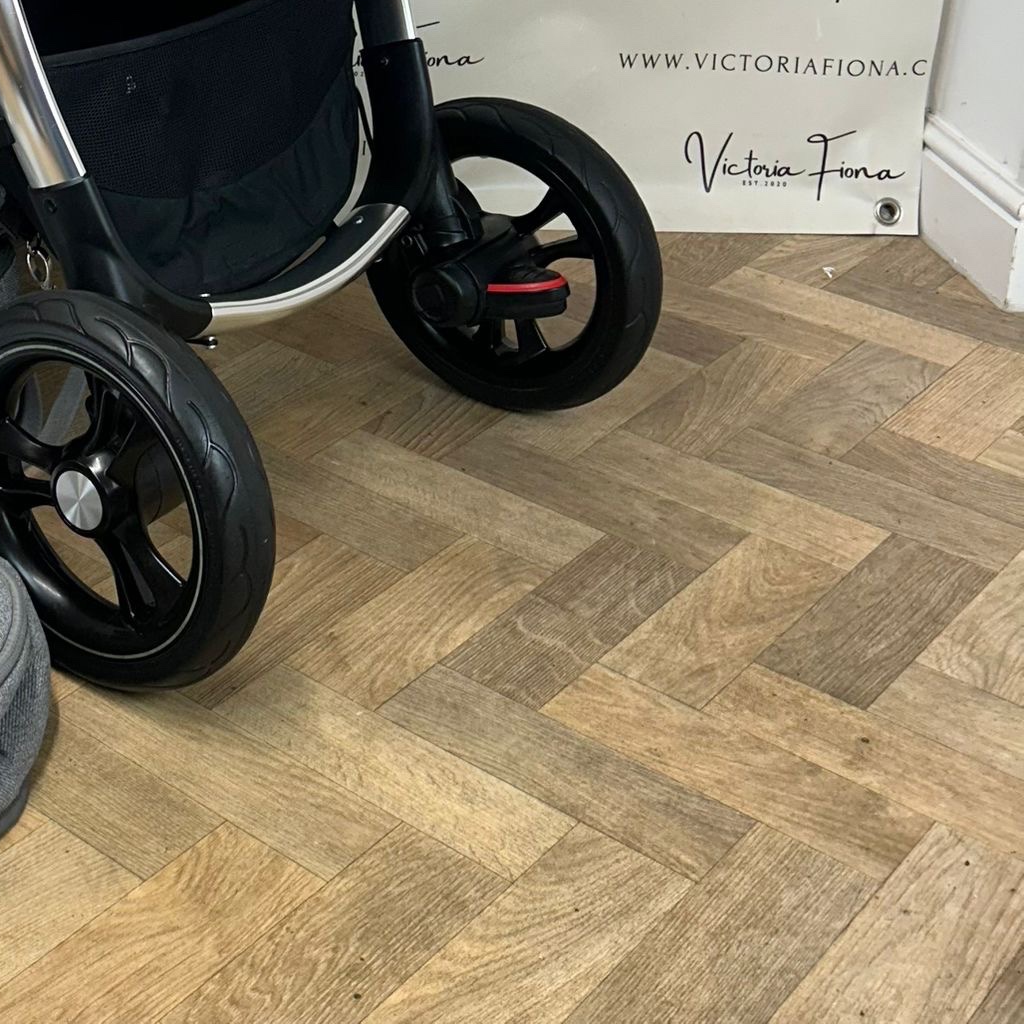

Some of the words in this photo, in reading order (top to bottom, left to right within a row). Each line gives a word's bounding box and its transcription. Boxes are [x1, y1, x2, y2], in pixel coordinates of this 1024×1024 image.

[619, 53, 927, 77] WWW.VICTORIAFIONA.C
[684, 131, 805, 193] Victoria
[807, 130, 906, 201] Fiona
[742, 180, 788, 188] EST.2020
